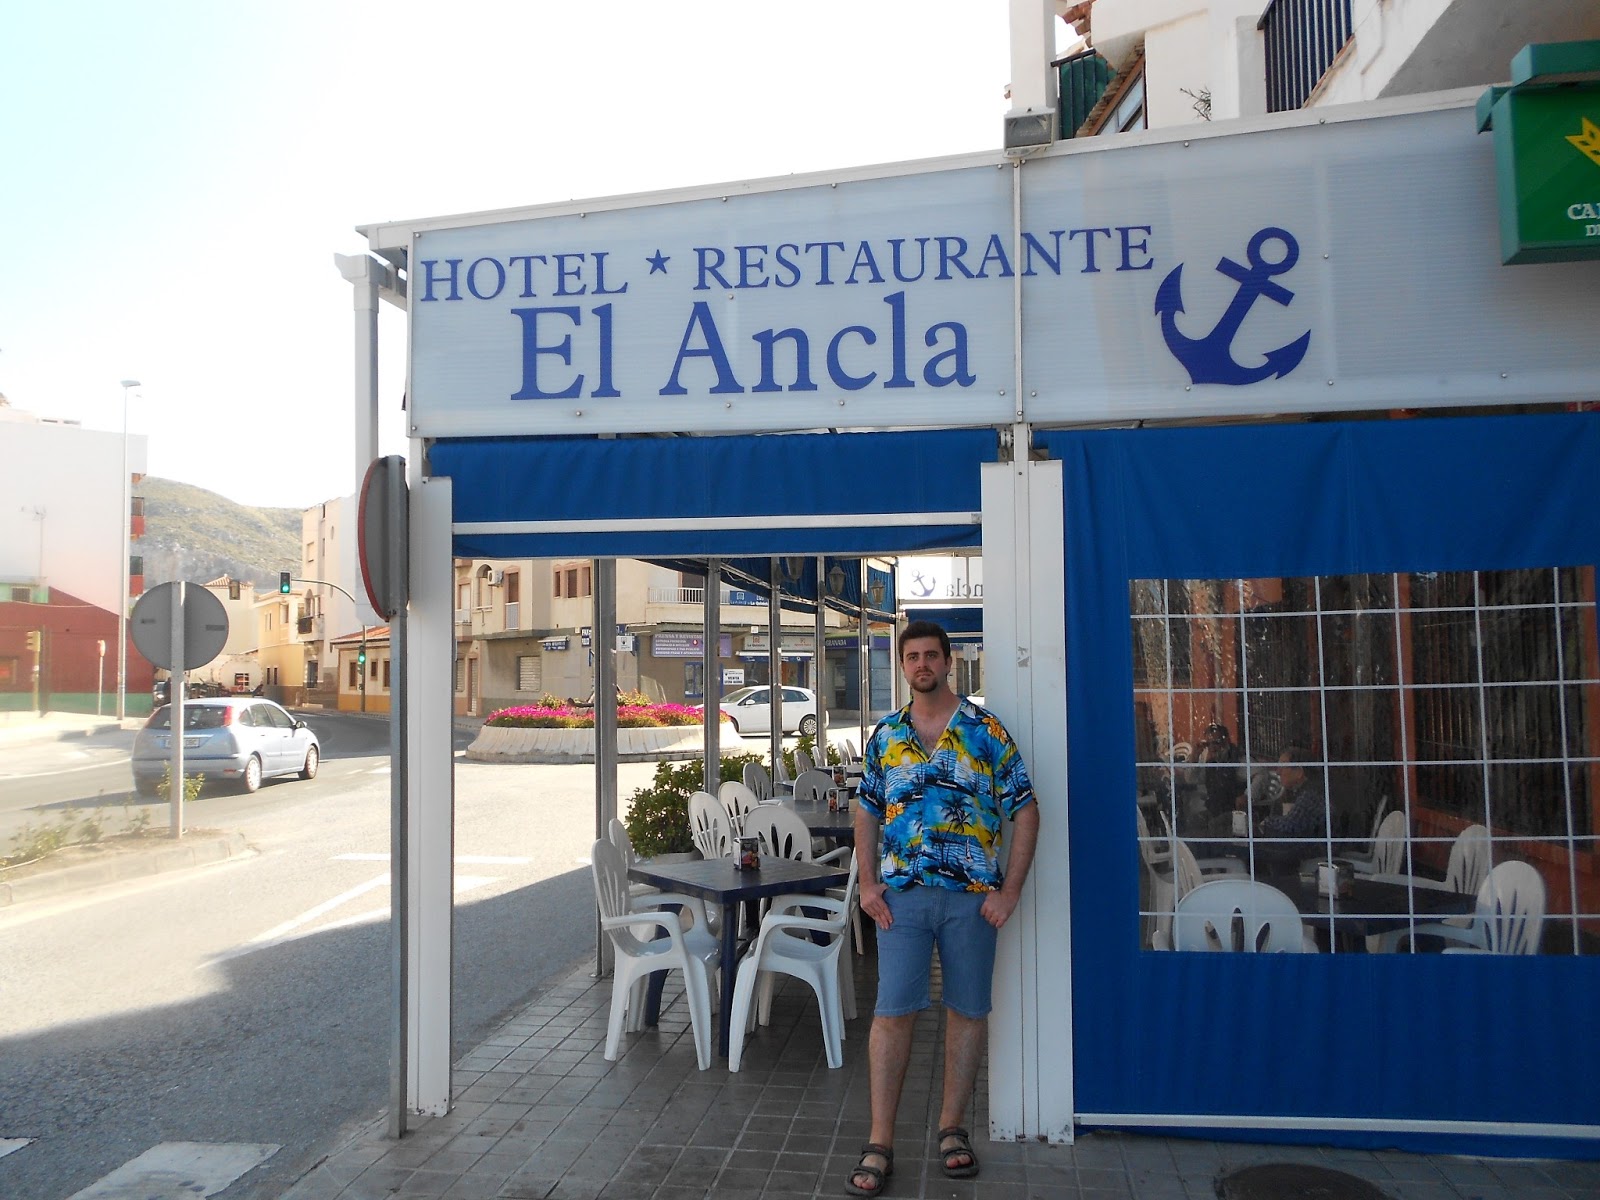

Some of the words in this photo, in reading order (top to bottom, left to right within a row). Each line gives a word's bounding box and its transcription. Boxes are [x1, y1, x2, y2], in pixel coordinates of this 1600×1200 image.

[1567, 203, 1600, 220] CA
[1585, 224, 1600, 236] D
[420, 251, 628, 302] HOTEL
[692, 225, 1155, 291] RESTAURANTE
[510, 303, 621, 401] El
[659, 290, 976, 394] Ancla
[825, 639, 847, 647] GRANADA
